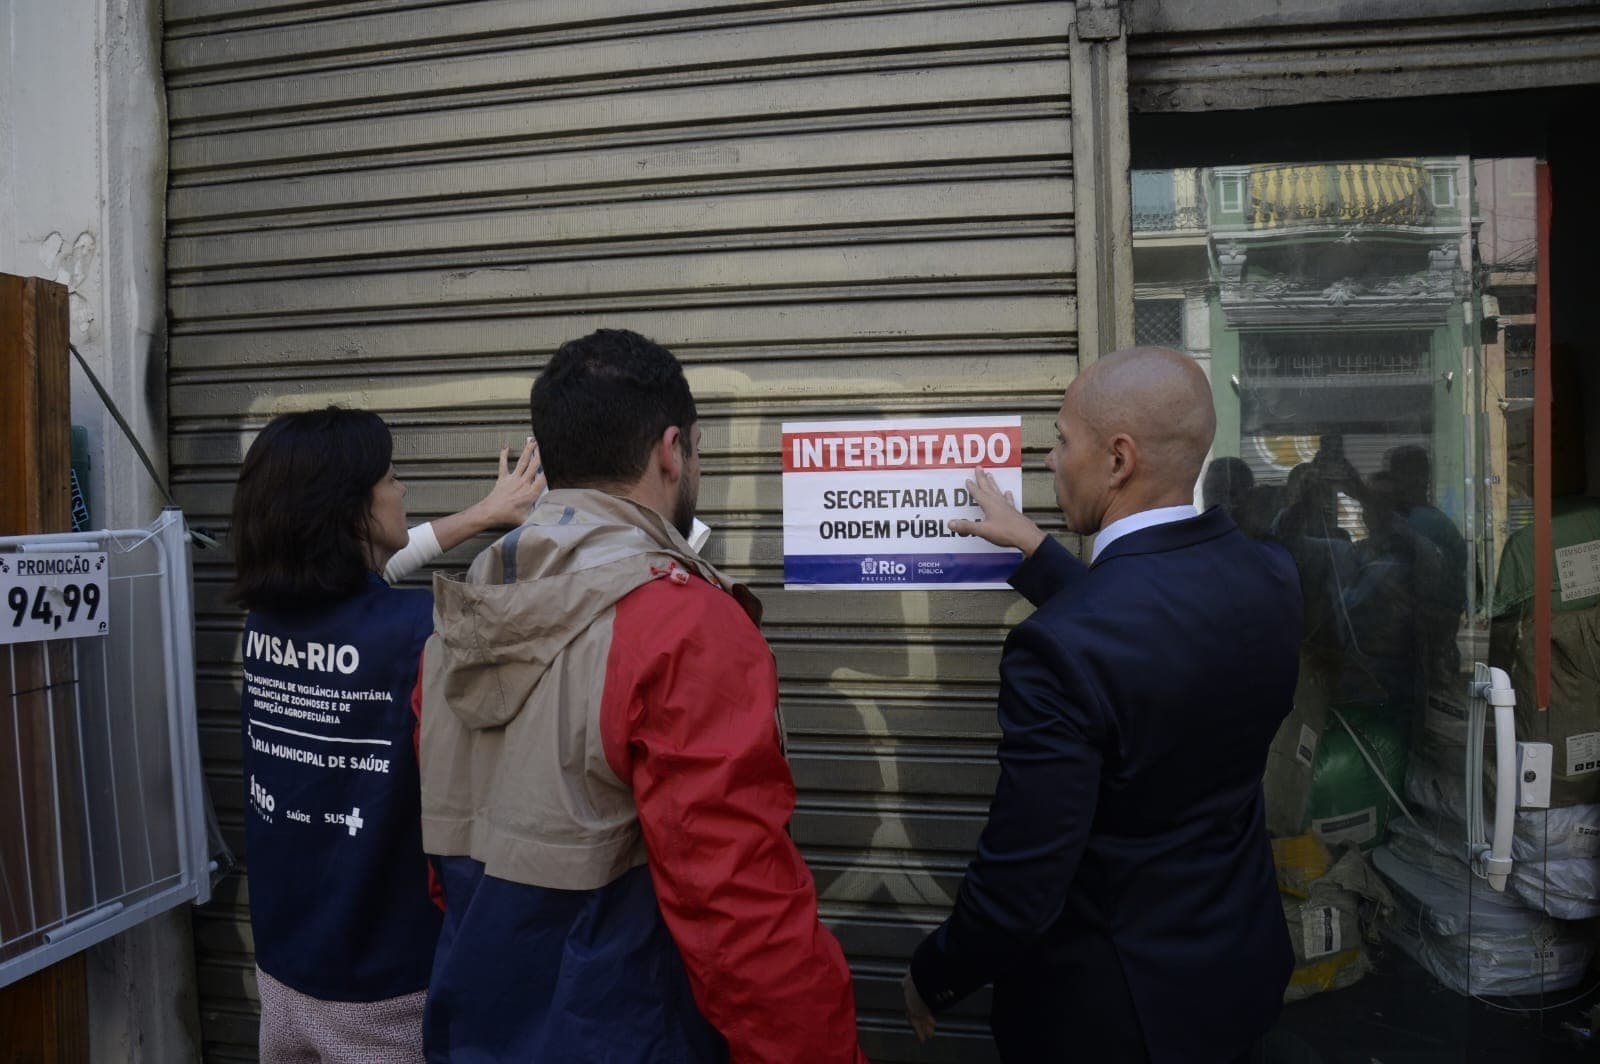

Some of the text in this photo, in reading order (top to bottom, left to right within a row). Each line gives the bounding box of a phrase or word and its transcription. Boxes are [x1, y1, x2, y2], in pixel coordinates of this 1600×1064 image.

[792, 432, 1011, 468] INTERDITADO
[824, 488, 948, 509] SECRETARIA
[820, 520, 890, 539] ORDEM
[880, 560, 906, 574] Rio
[8, 582, 100, 632] 94,99
[254, 676, 286, 690] MUNICIPAL
[288, 682, 296, 692] DE
[298, 685, 339, 698] VIGILÂNCIA
[341, 689, 392, 702] SANITÁRIA,
[282, 694, 290, 704] DE
[291, 696, 330, 710] ZOONOSES
[332, 702, 336, 710] E
[340, 702, 350, 712] DE
[284, 708, 340, 724] AGROPECUÁRIA
[271, 741, 325, 768] MUNICIPAL
[328, 756, 346, 768] DE
[350, 754, 390, 773] SAÚDE
[286, 810, 312, 824] SAÚDE
[324, 813, 345, 824] SUS
